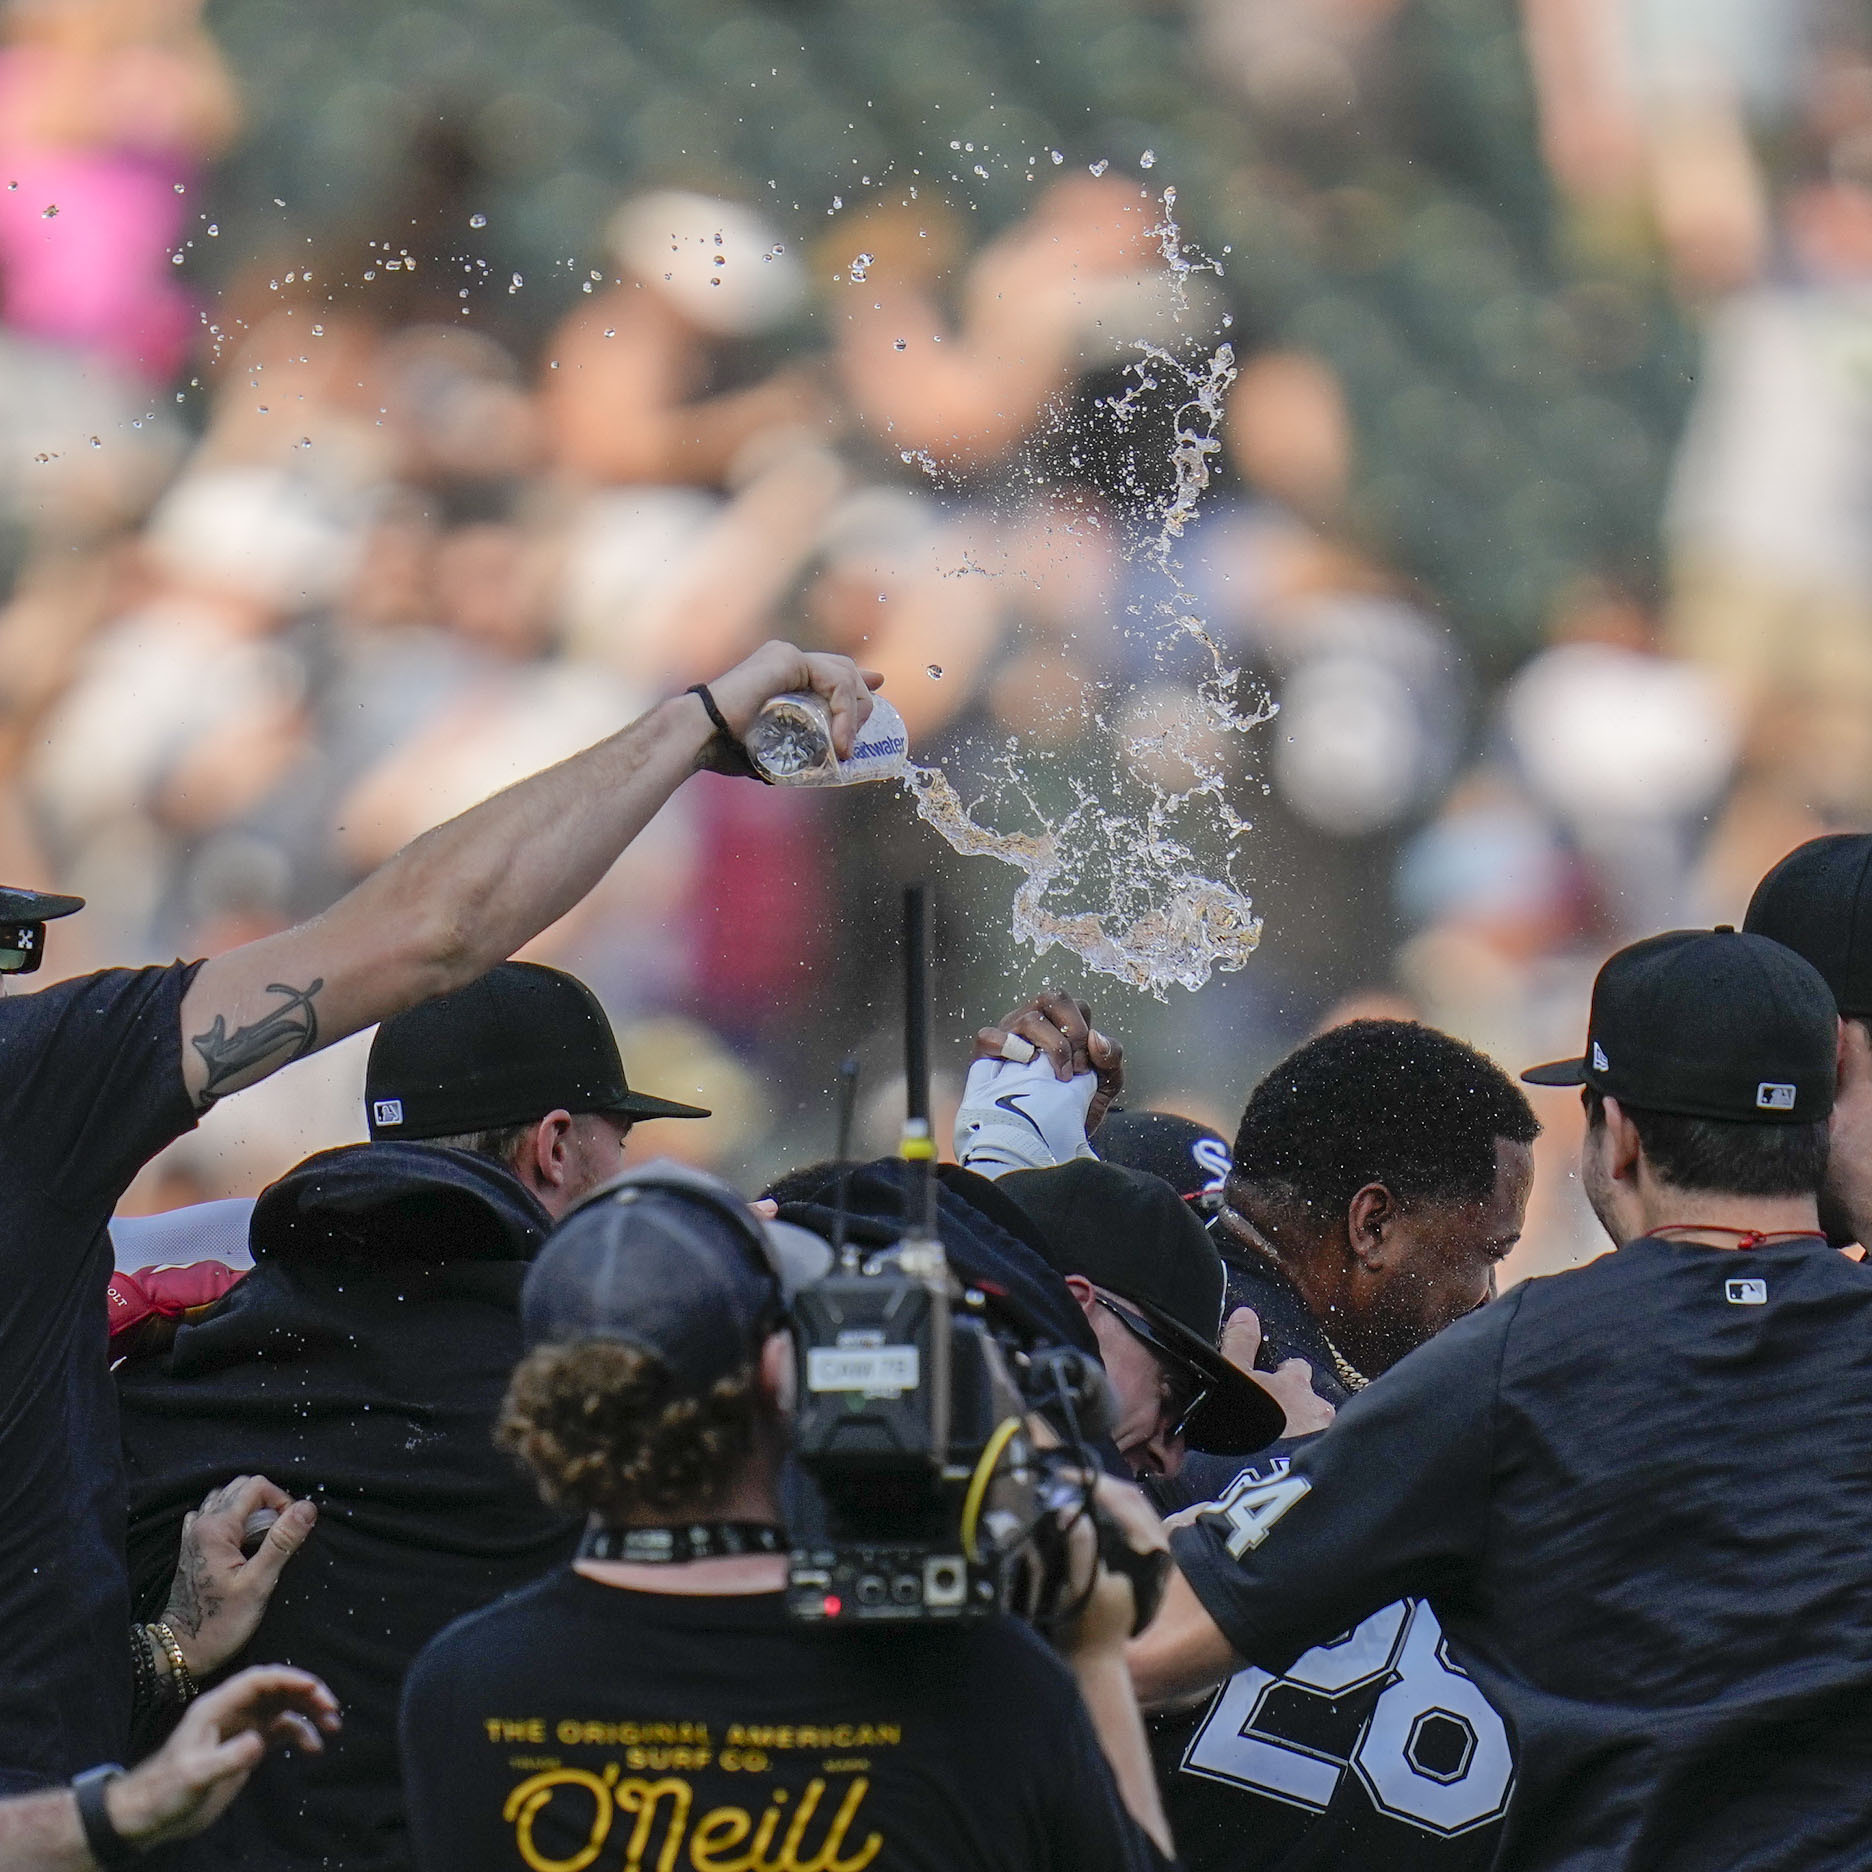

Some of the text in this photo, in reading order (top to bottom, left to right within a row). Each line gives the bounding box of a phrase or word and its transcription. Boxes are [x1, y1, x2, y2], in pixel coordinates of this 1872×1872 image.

[107, 1285, 128, 1307] OLT
[484, 1717, 901, 1749] THE ORIGINAL AMERICAN
[627, 1746, 773, 1772] SURF CO.
